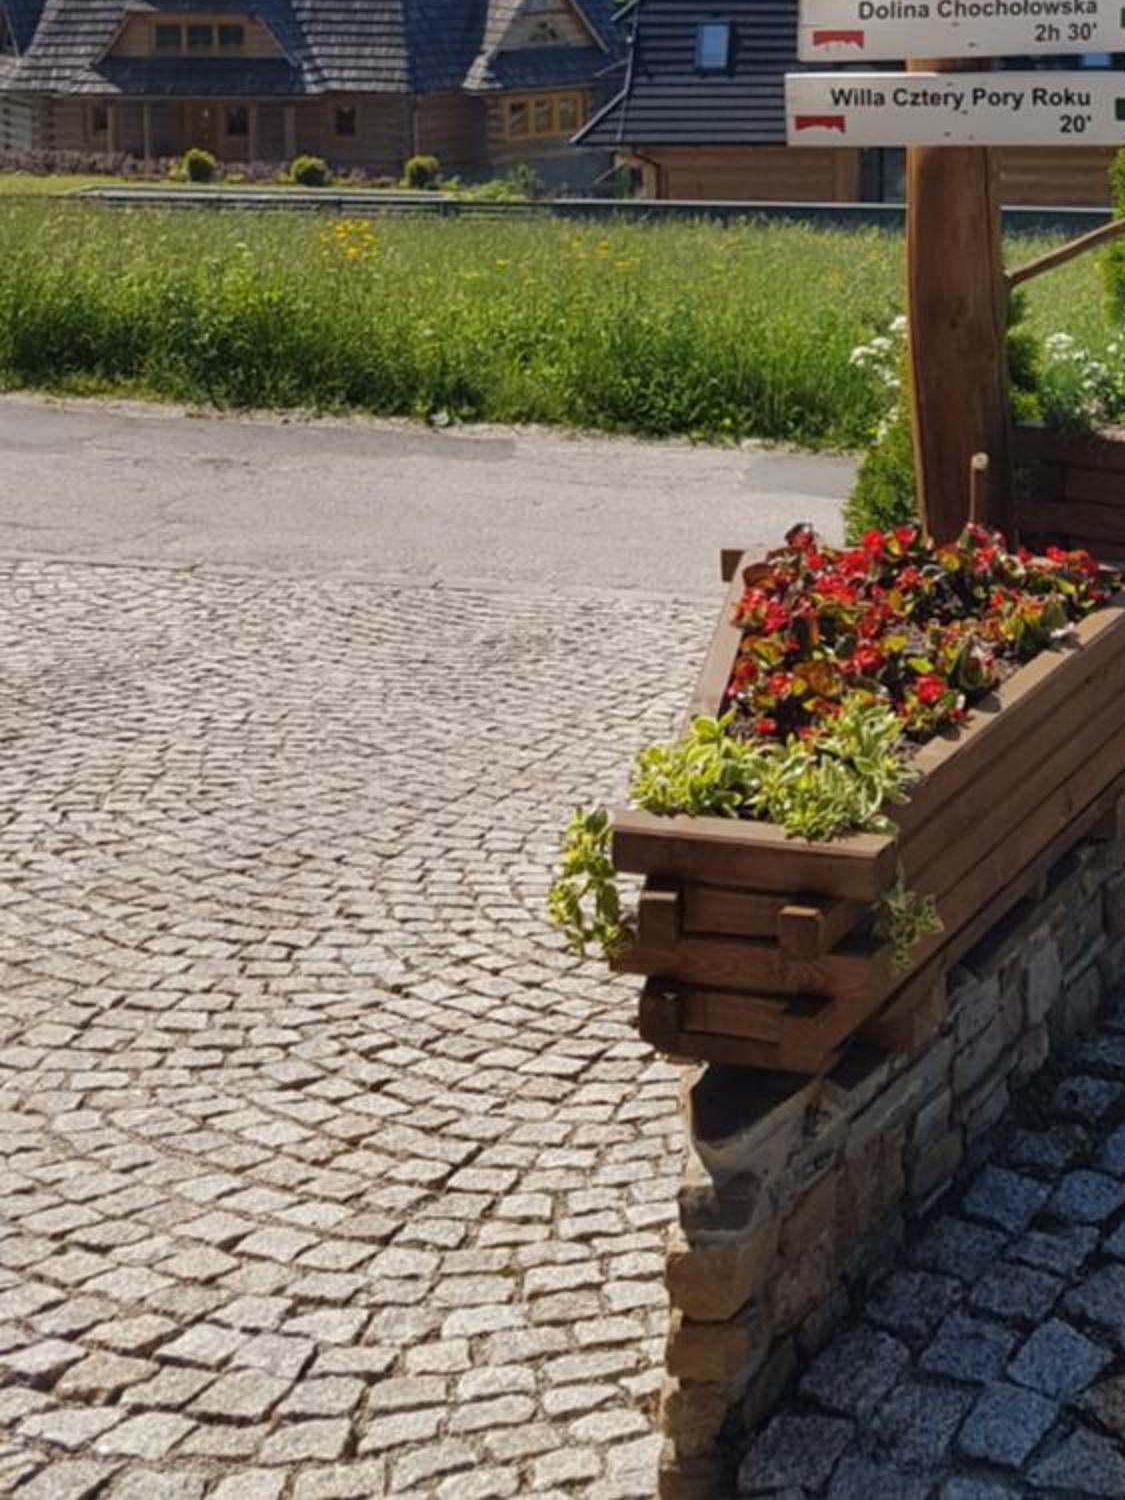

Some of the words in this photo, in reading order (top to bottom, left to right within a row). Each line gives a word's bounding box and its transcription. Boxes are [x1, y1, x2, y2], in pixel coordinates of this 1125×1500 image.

[858, 0, 929, 20] Dolina
[1034, 22, 1059, 42] 2h
[1067, 22, 1098, 41] 30'
[830, 88, 886, 108] Willa
[892, 88, 964, 111] Cztery
[972, 88, 1026, 111] Pory
[1032, 87, 1092, 107] Roku
[1060, 115, 1092, 134] 20'
